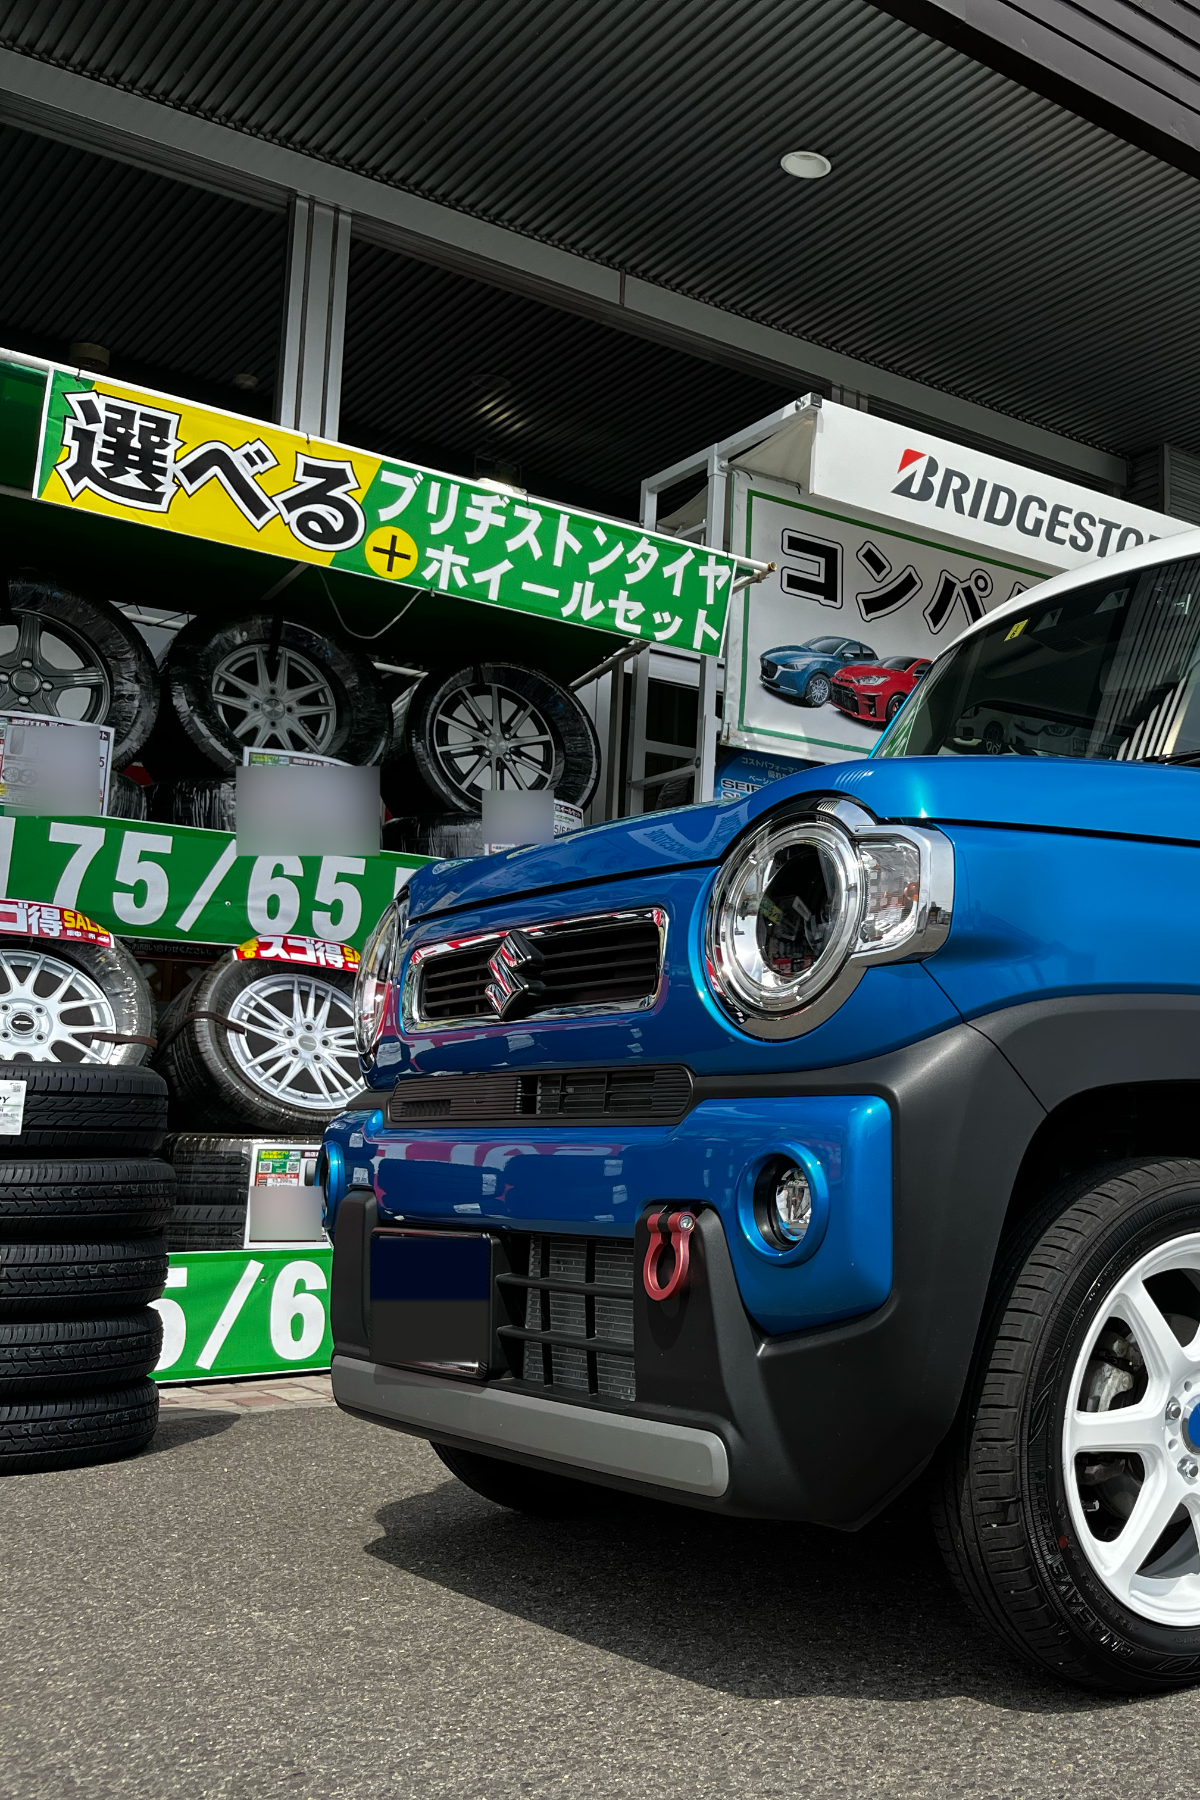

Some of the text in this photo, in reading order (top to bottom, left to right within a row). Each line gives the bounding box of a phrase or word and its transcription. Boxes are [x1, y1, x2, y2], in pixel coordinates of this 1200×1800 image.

[55, 390, 365, 551] 選べる
[890, 448, 1163, 558] BRIDGESTO
[378, 470, 731, 604] ブリヂストンタイヤ
[421, 544, 721, 650] ホイールセット
[741, 757, 798, 773] コストパフォーマ
[64, 910, 109, 935] SALE
[258, 936, 345, 968] スゴ得
[343, 946, 361, 963] SA
